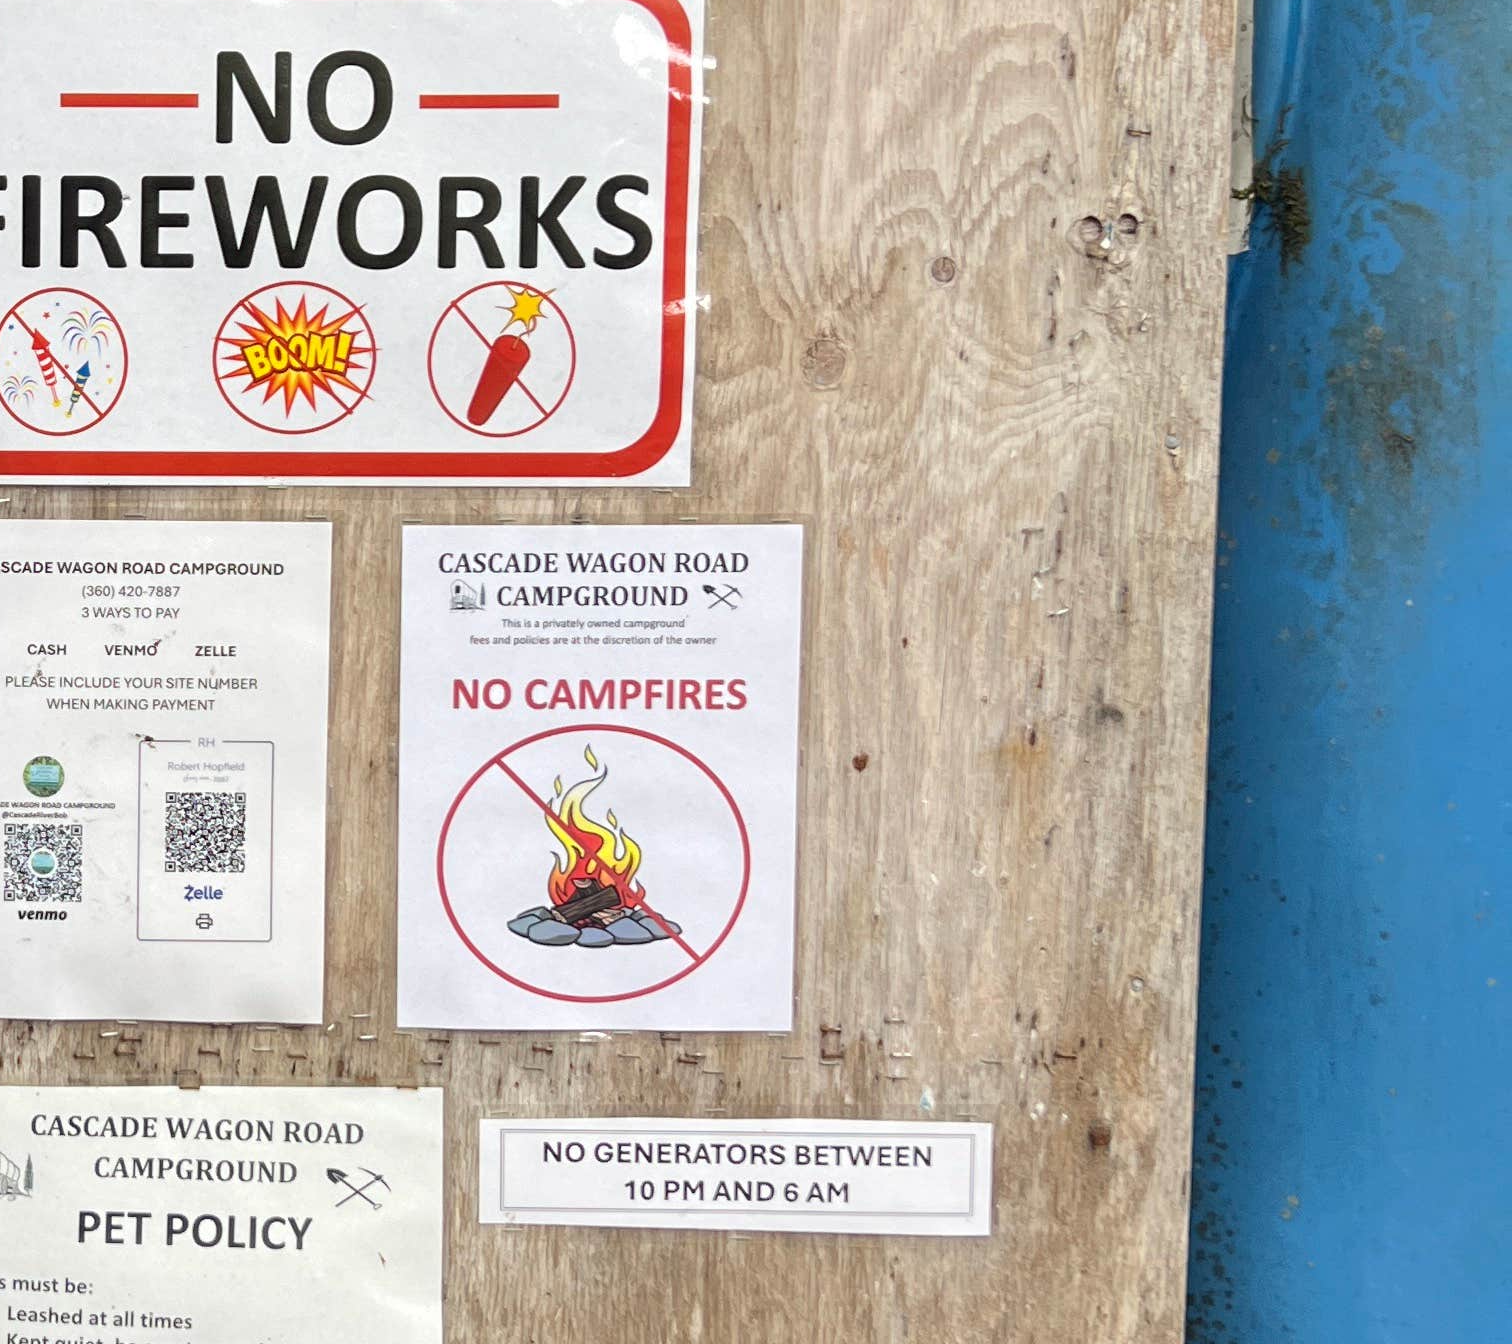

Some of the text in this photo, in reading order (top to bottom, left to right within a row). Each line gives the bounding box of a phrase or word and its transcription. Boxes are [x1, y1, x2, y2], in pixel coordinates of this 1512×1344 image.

[215, 50, 393, 146] NO
[241, 329, 354, 382] BOOM!
[56, 561, 117, 574] WAGON
[122, 562, 165, 574] ROAD
[169, 562, 284, 575] CAMPGROUND
[438, 552, 748, 573] CASCADE WAGON ROAD
[81, 585, 180, 599] (360) 420-7887
[496, 585, 688, 606] CAMPGROUND
[81, 606, 180, 619] 3 WAYS TO PAY
[27, 643, 236, 657] CASH VENMO ZELLE
[452, 678, 747, 710] NO CAMPFIRES
[183, 884, 223, 901] Zelle
[17, 910, 67, 920] venmo
[31, 1114, 363, 1144] CASCADE WAGON ROAD
[543, 1141, 931, 1166] NO GENERATORS BETWEEN
[94, 1156, 297, 1183] CAMPGROUND
[624, 1180, 848, 1203] 10 PM AND 6 AM
[77, 1210, 312, 1250] PET POLICY
